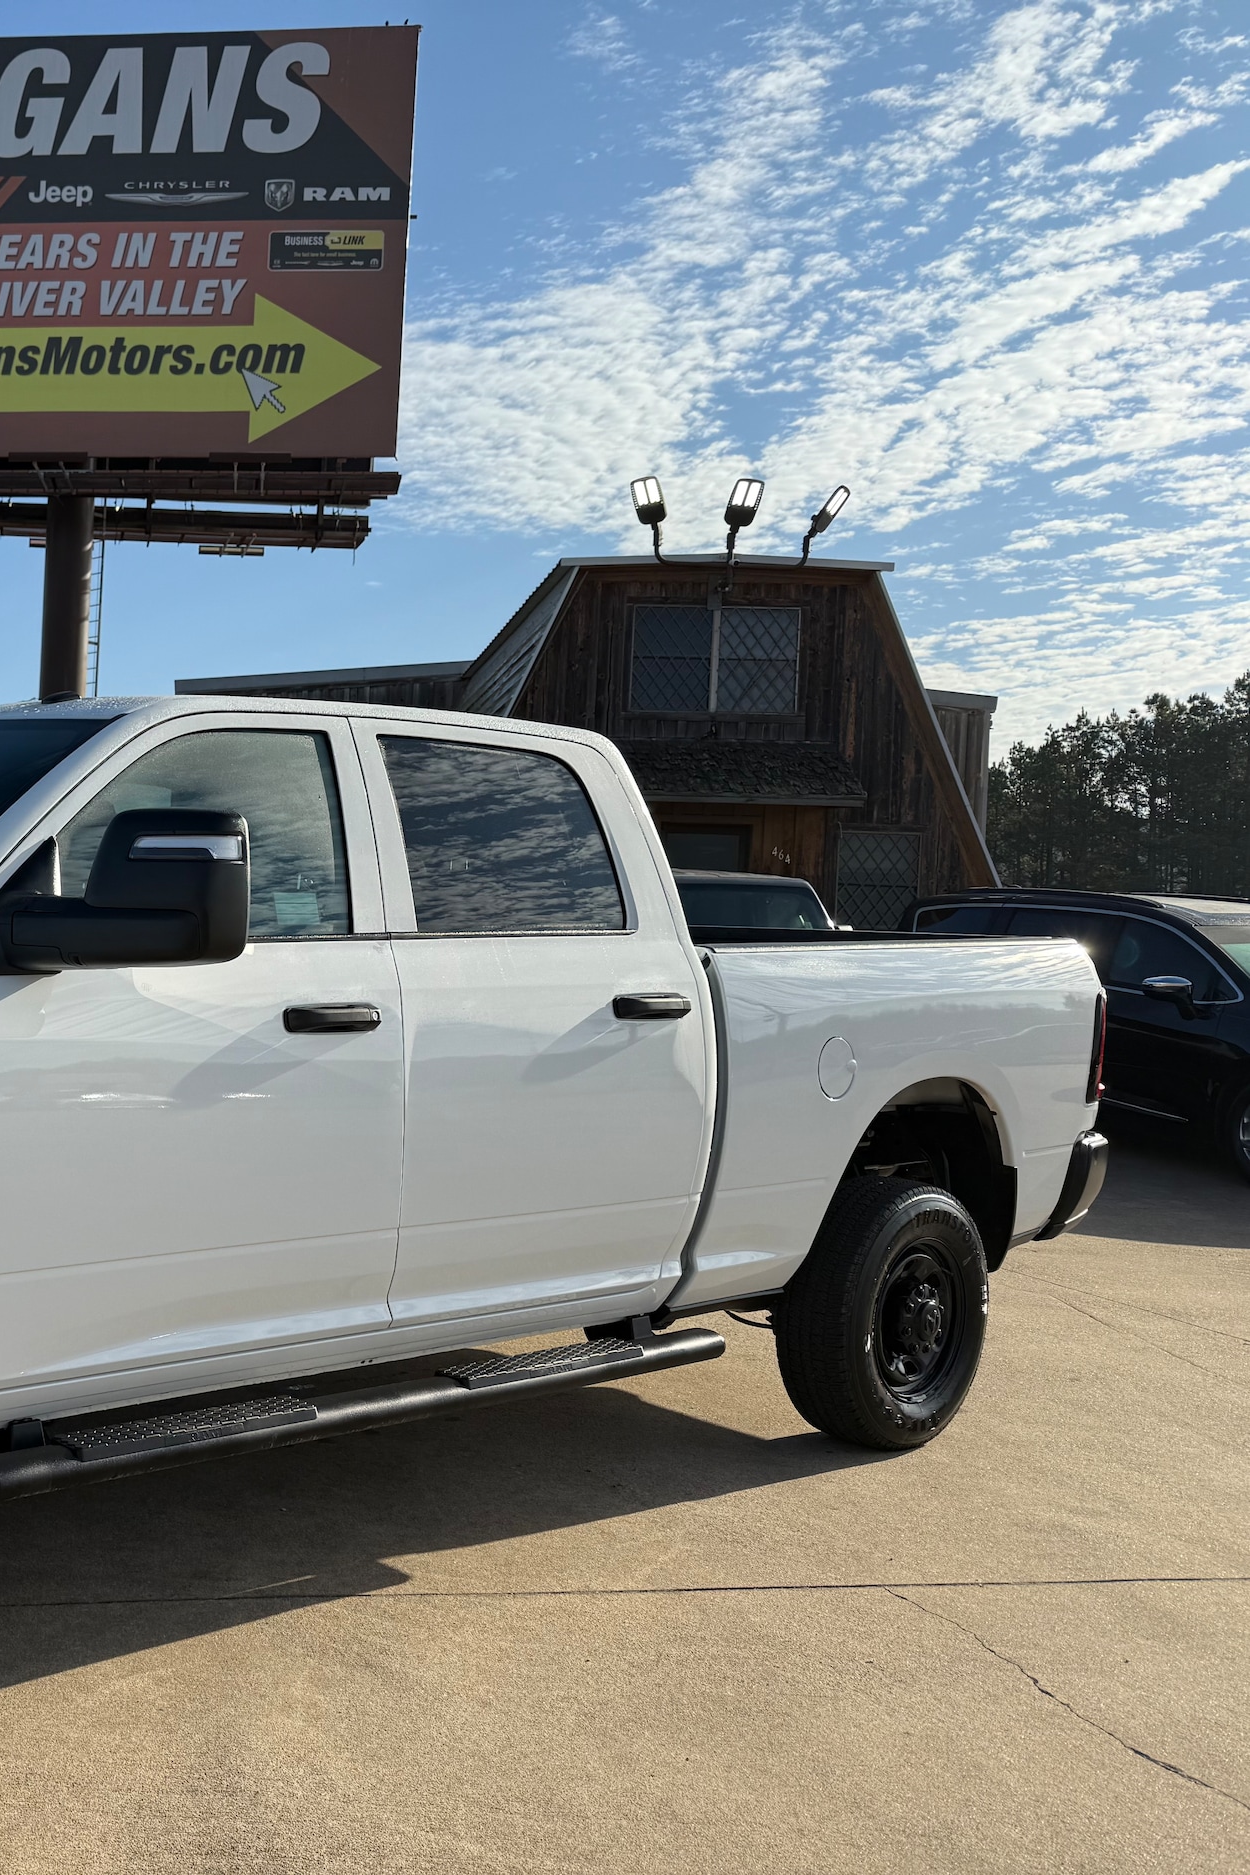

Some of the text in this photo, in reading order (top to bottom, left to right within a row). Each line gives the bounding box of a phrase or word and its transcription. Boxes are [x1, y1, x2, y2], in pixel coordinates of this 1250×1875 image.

[28, 180, 93, 207] Jeep
[124, 181, 231, 190] CHRYSLER
[303, 186, 391, 202] RAM
[111, 233, 157, 269] IN
[169, 231, 245, 268] THE
[285, 235, 365, 246] BUSINESS LINK
[99, 279, 247, 317] VALLEY
[771, 846, 791, 865] 464
